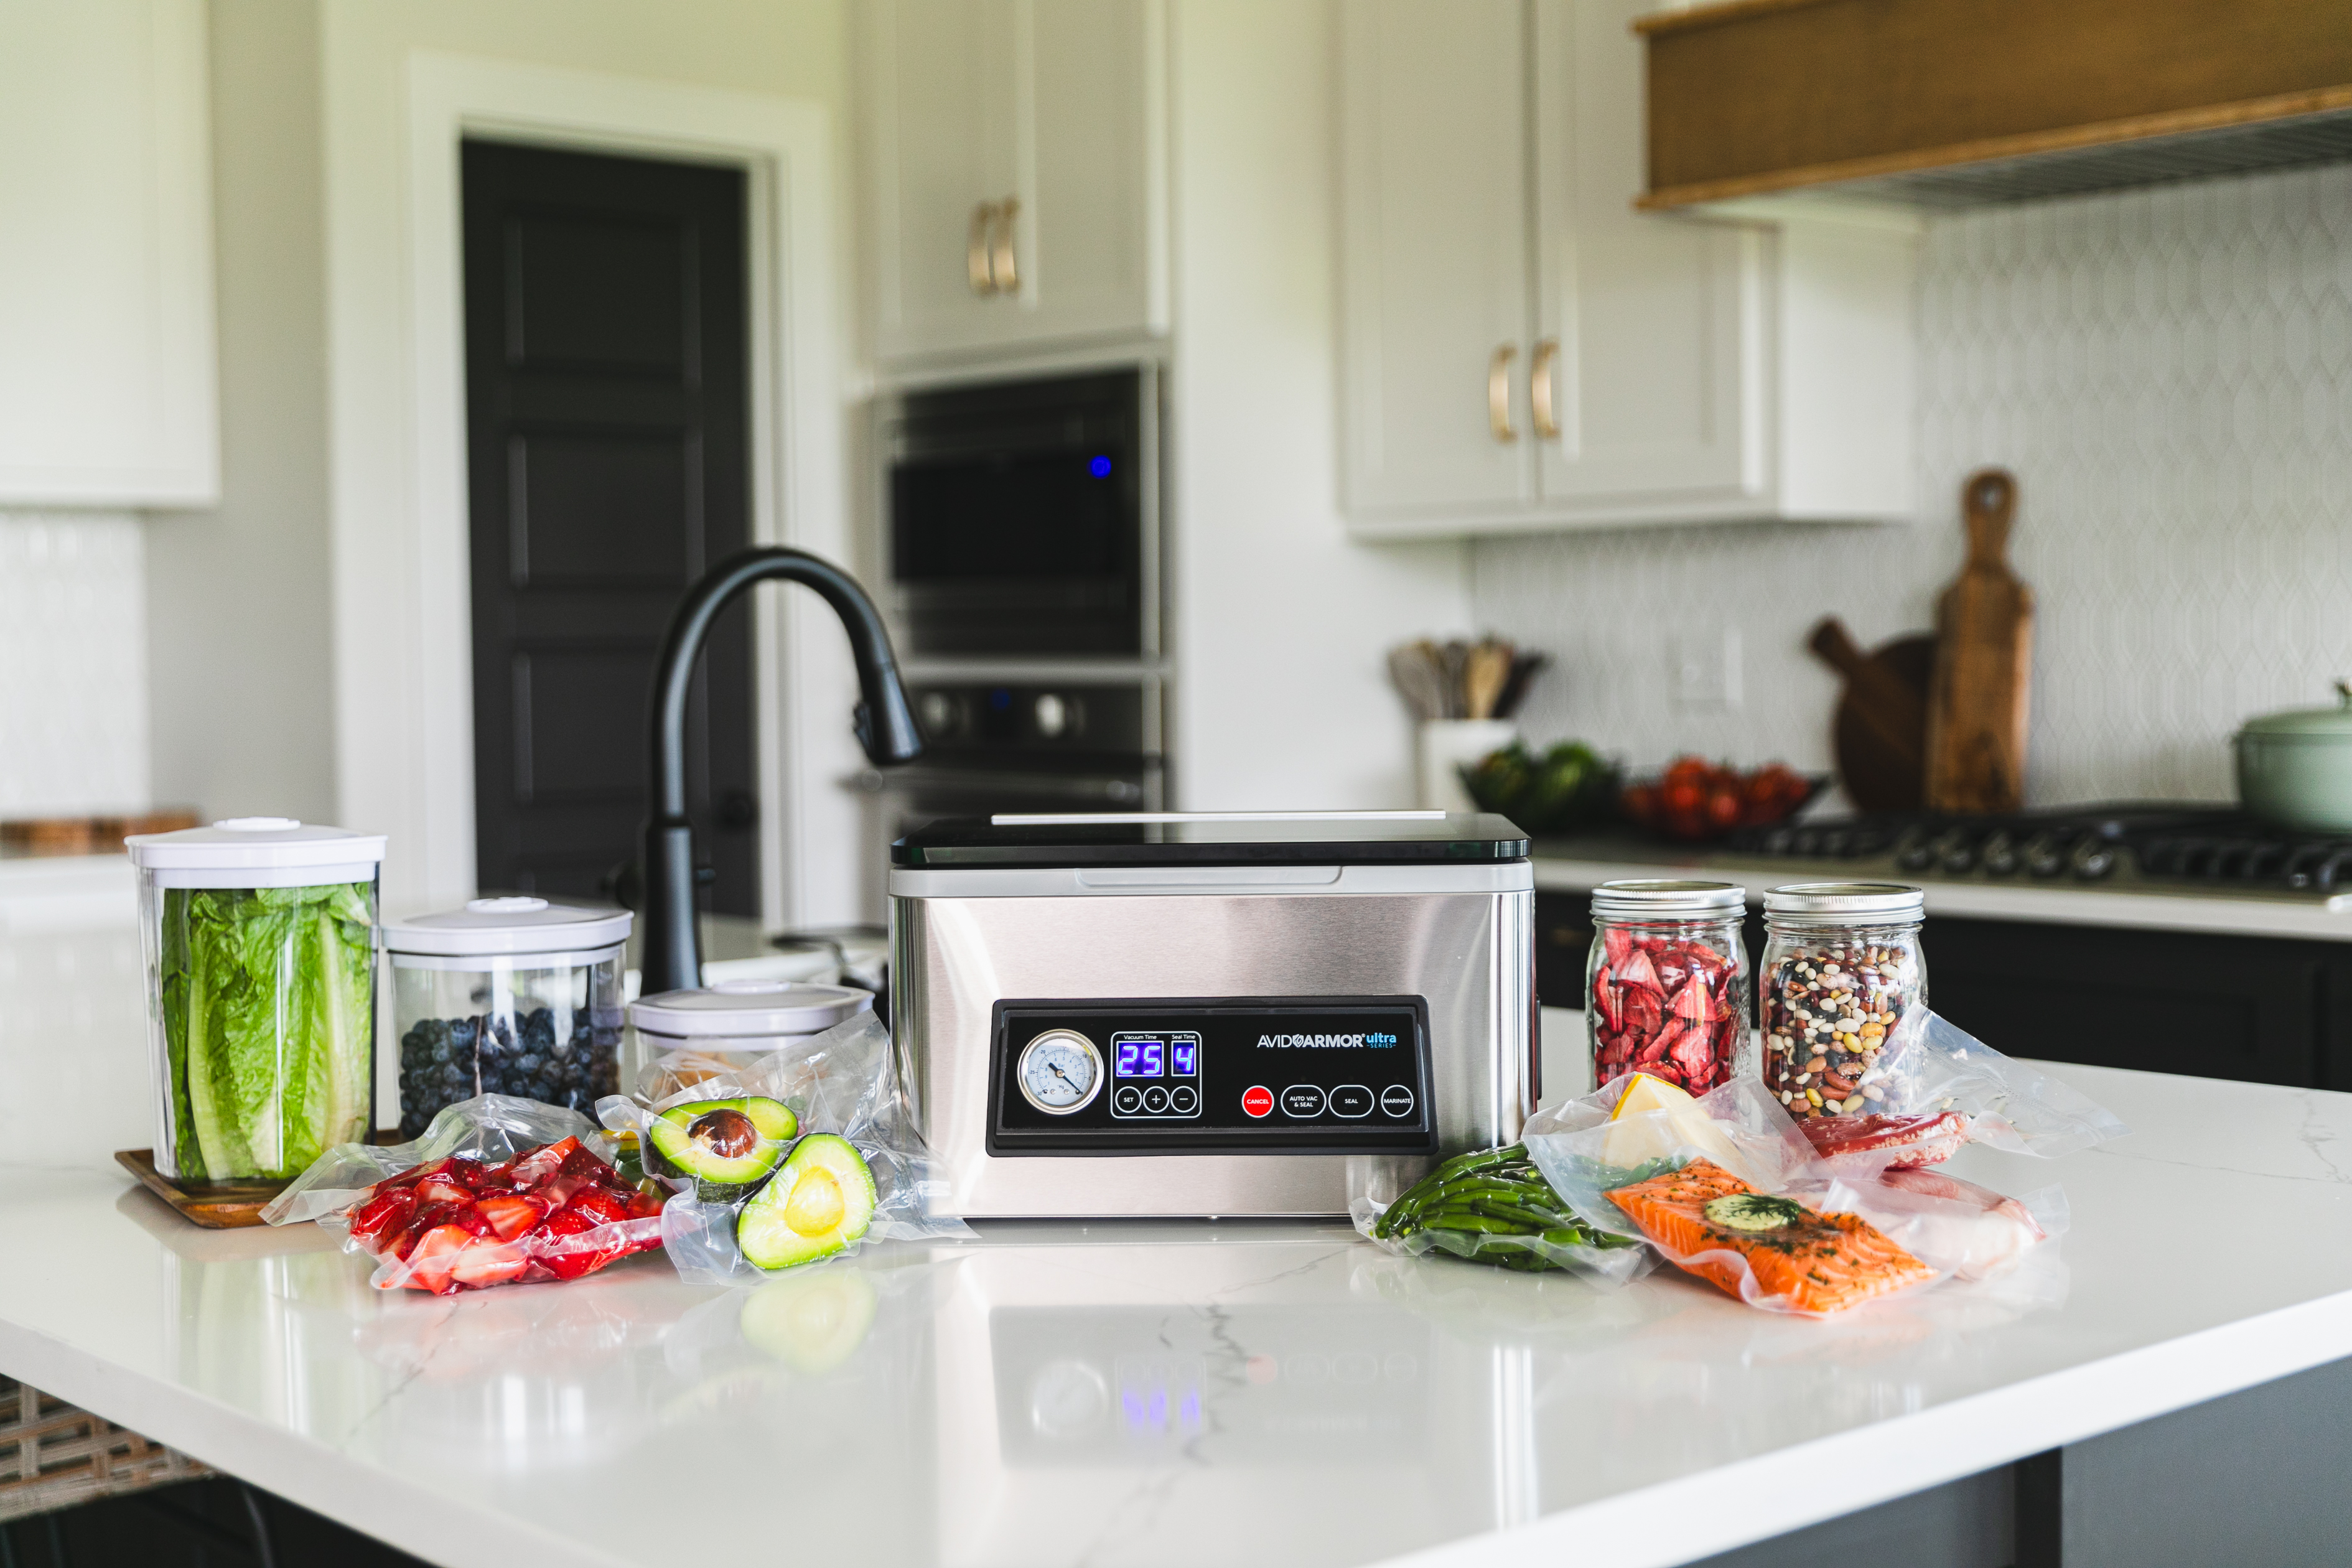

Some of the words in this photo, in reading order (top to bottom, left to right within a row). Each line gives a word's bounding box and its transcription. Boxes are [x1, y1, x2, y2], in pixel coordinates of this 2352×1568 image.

[1366, 1032, 1397, 1043] ultra
[1118, 1045, 1161, 1075] 25
[1176, 1047, 1194, 1071] 4
